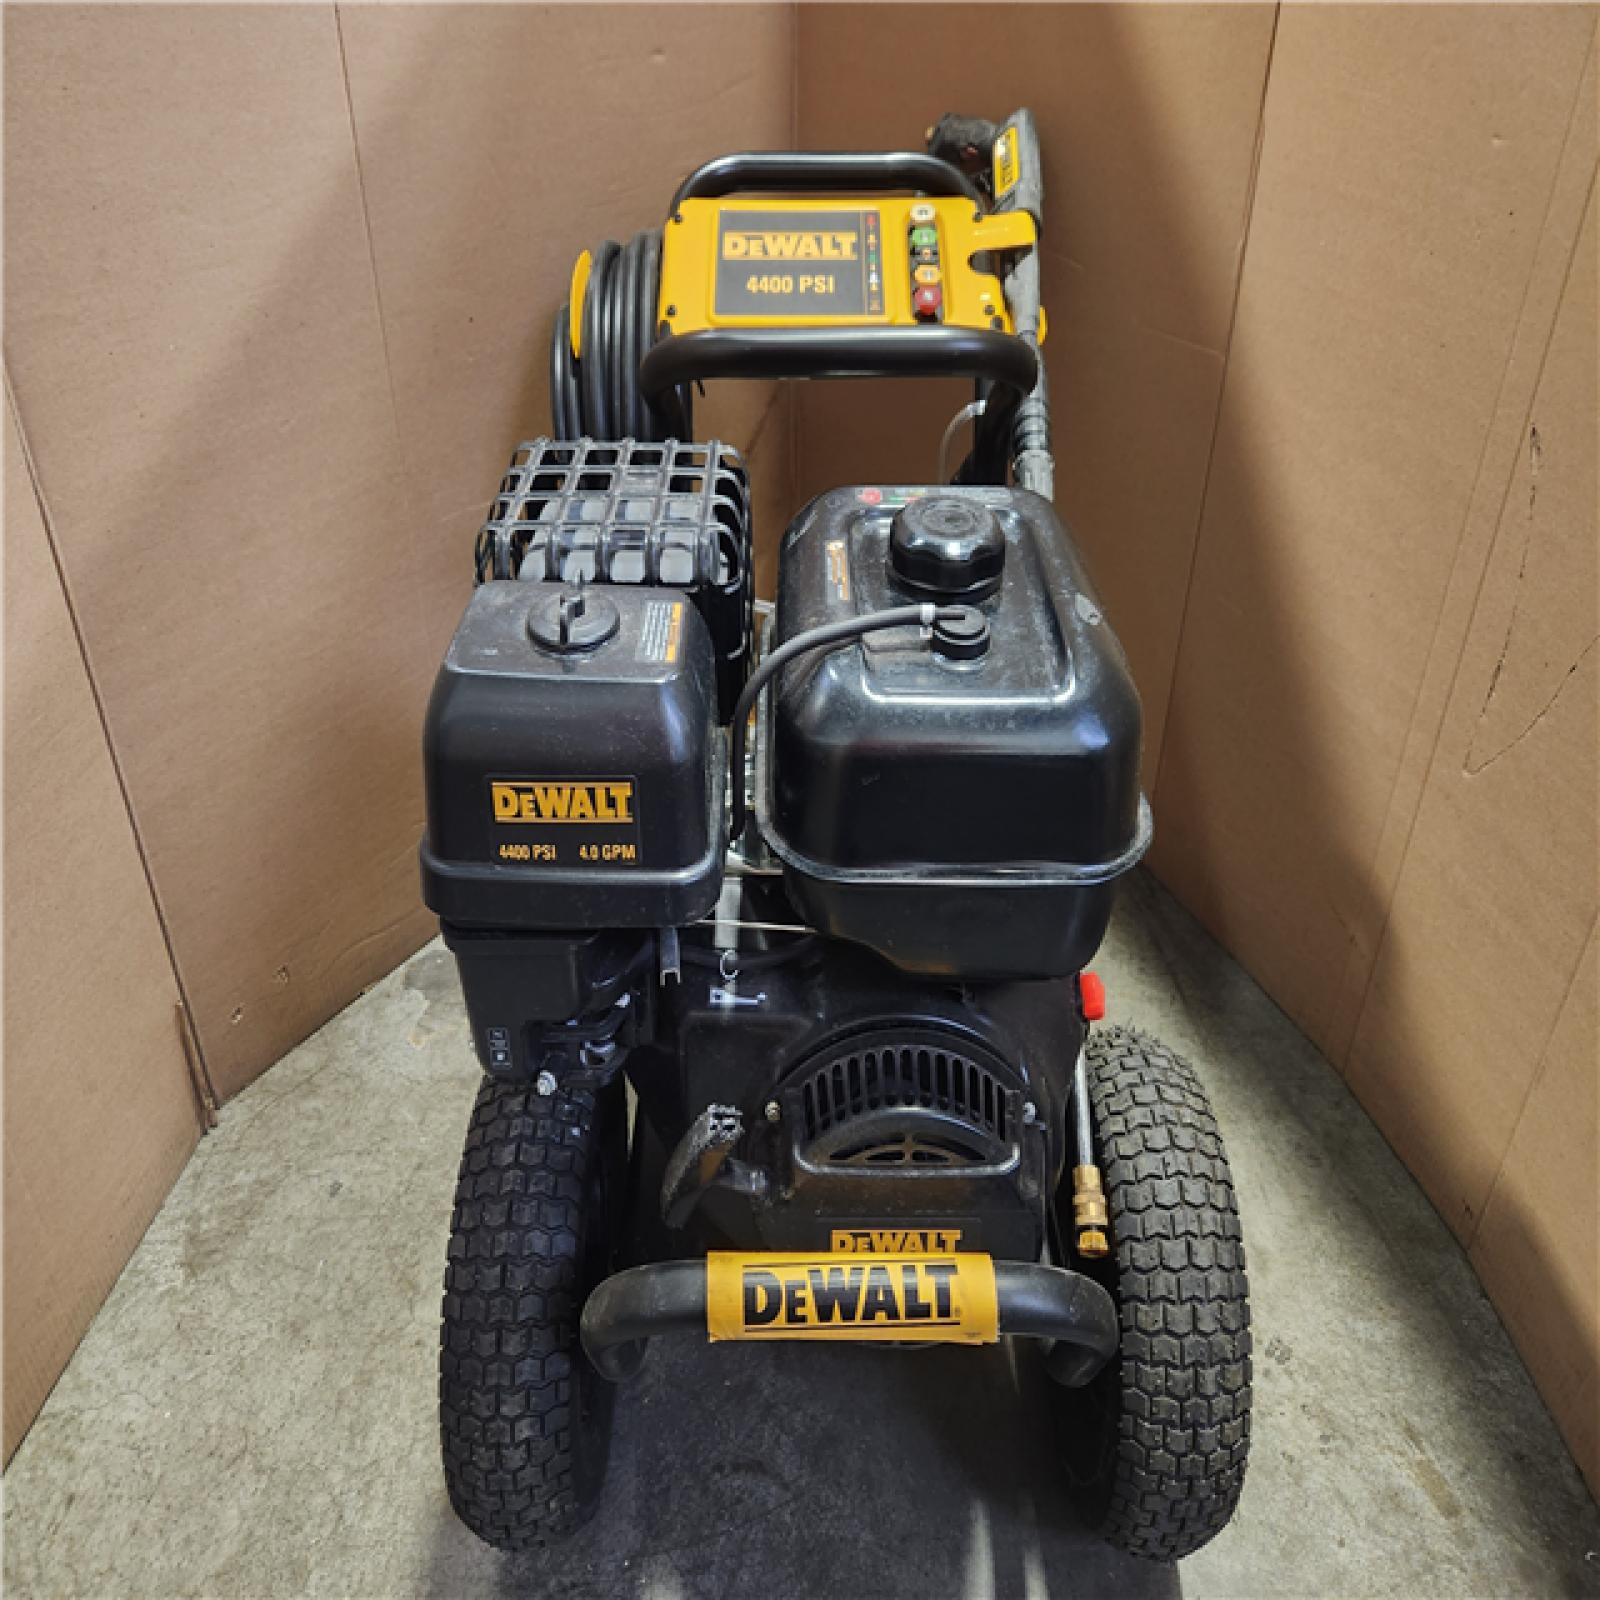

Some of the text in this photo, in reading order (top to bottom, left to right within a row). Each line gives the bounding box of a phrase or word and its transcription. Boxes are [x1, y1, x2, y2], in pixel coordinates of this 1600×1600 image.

[723, 232, 857, 260] DEWALT
[746, 275, 835, 294] 4400 PSI
[492, 782, 633, 823] DEWALT
[499, 844, 556, 860] 4400 PSI
[579, 844, 636, 860] 4.0 GPM
[832, 1230, 961, 1253] DEWALT
[743, 1264, 957, 1325] DEWALT
